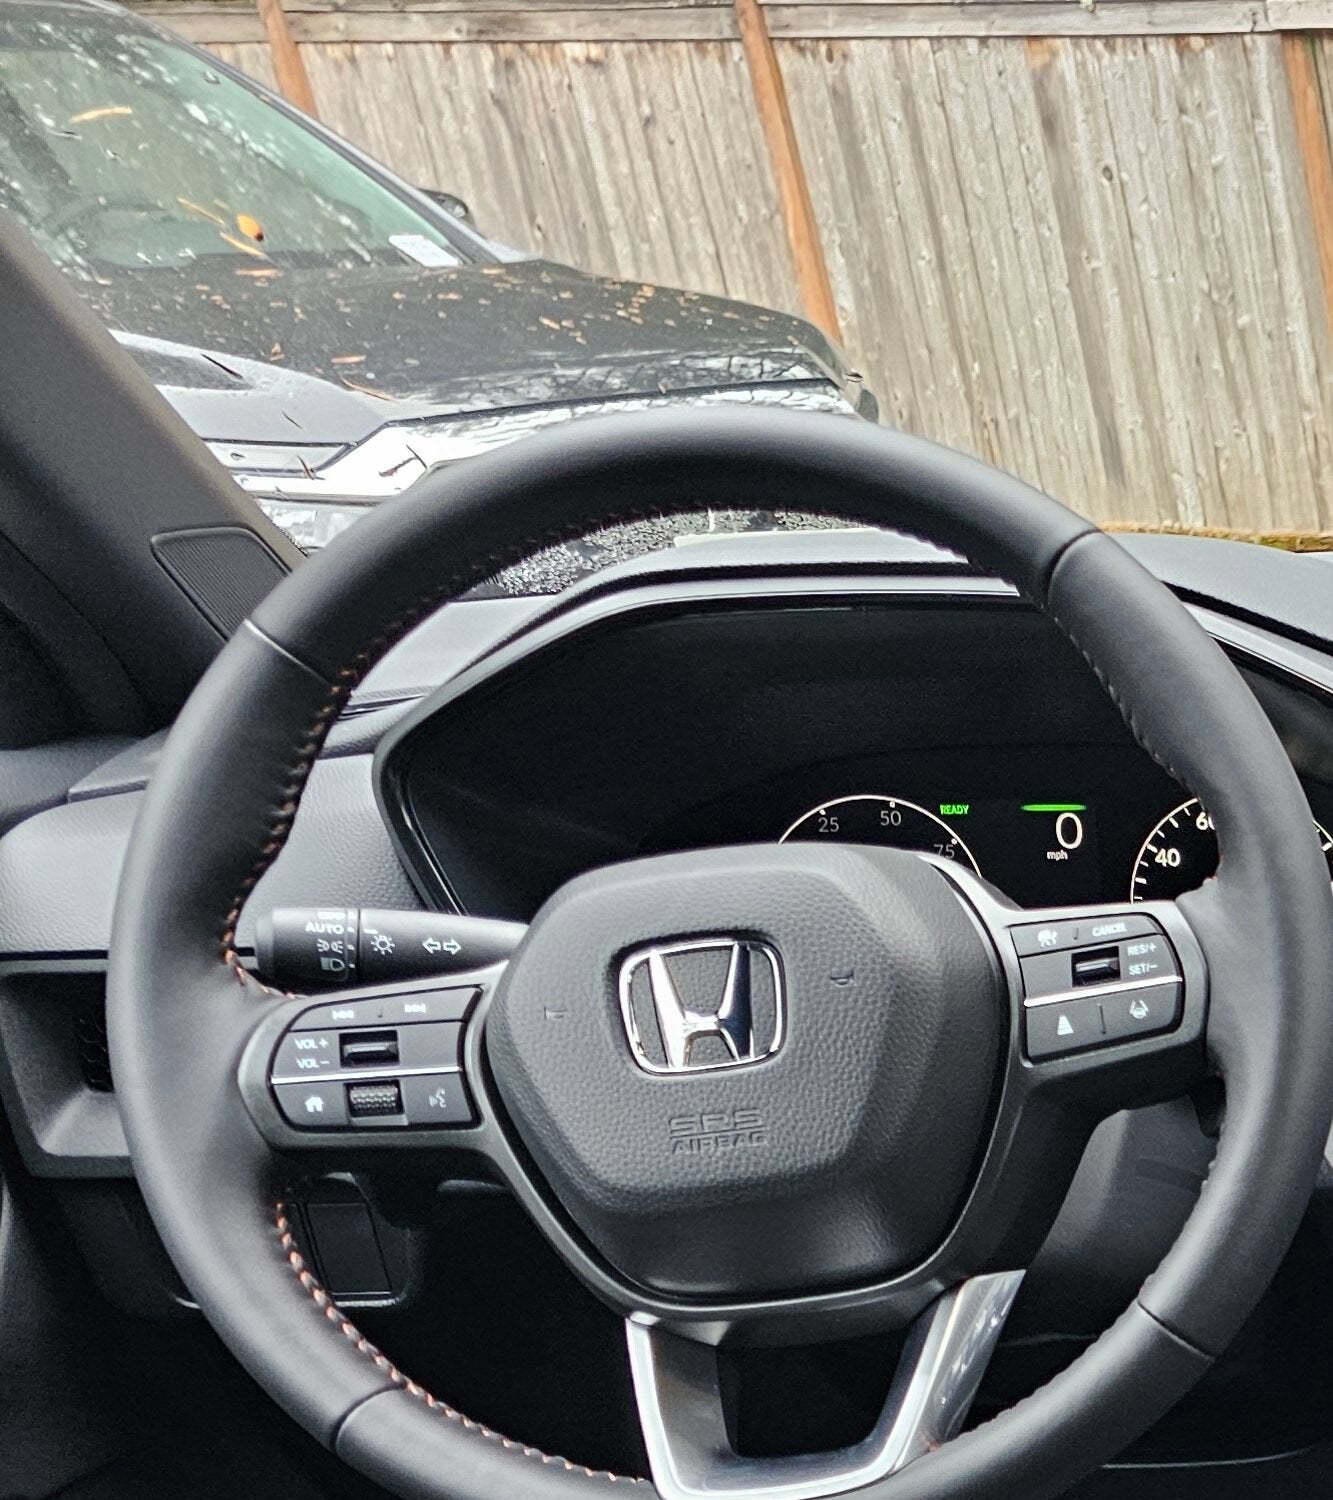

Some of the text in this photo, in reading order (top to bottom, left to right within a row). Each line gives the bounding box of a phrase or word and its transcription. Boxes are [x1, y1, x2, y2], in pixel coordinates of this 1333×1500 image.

[940, 804, 970, 815] READY
[818, 817, 839, 833] 25
[880, 811, 902, 826] 50
[1056, 812, 1083, 850] 0
[933, 843, 955, 859] 75
[1047, 850, 1068, 861] mph
[1154, 848, 1181, 868] 40
[305, 920, 345, 935] AUTO
[1092, 922, 1128, 937] CANCEL
[669, 1107, 764, 1135] SRS
[672, 1130, 768, 1154] AIRBAG
